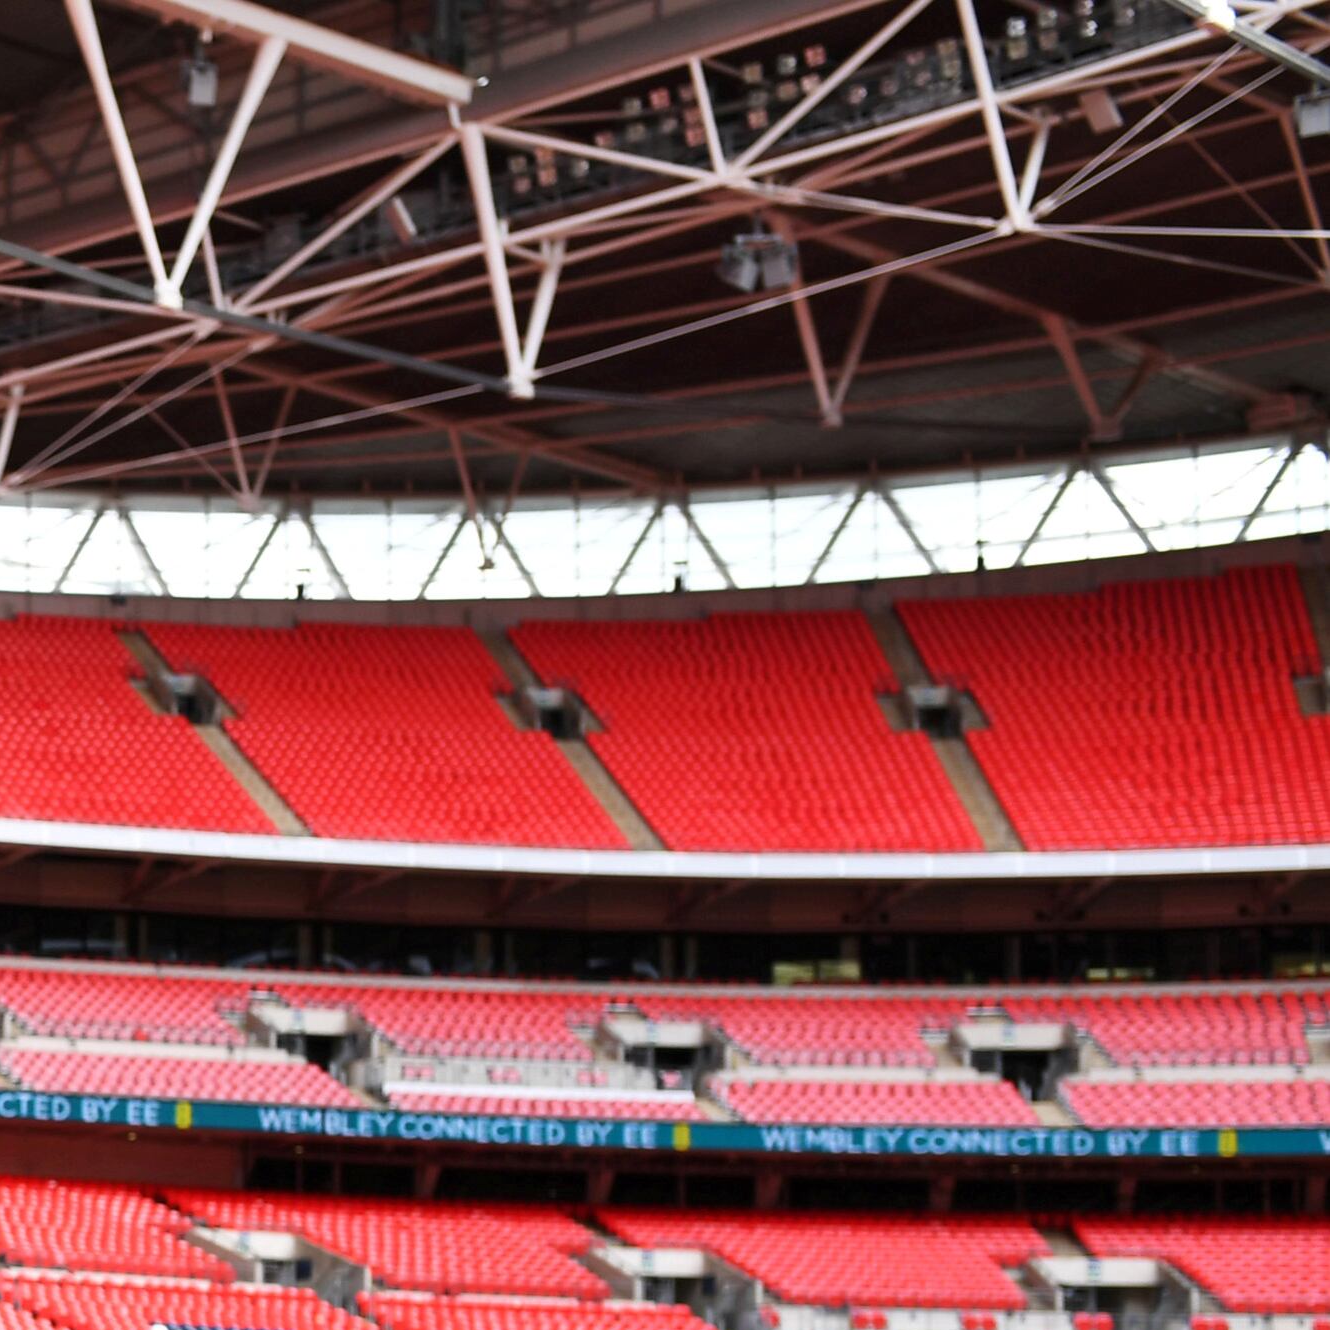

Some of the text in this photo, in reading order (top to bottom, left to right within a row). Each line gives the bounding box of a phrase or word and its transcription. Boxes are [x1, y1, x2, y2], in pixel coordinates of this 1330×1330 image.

[82, 1099, 116, 1124] BY
[127, 1102, 160, 1127] EE
[258, 1107, 393, 1138] WEMBLEY
[398, 1114, 564, 1146] CONNECTED
[577, 1122, 612, 1147] BY
[624, 1122, 656, 1149] EE
[762, 1126, 904, 1154] WEMBLEY
[907, 1129, 1094, 1157] CONNECTED
[1161, 1129, 1199, 1157] EE
